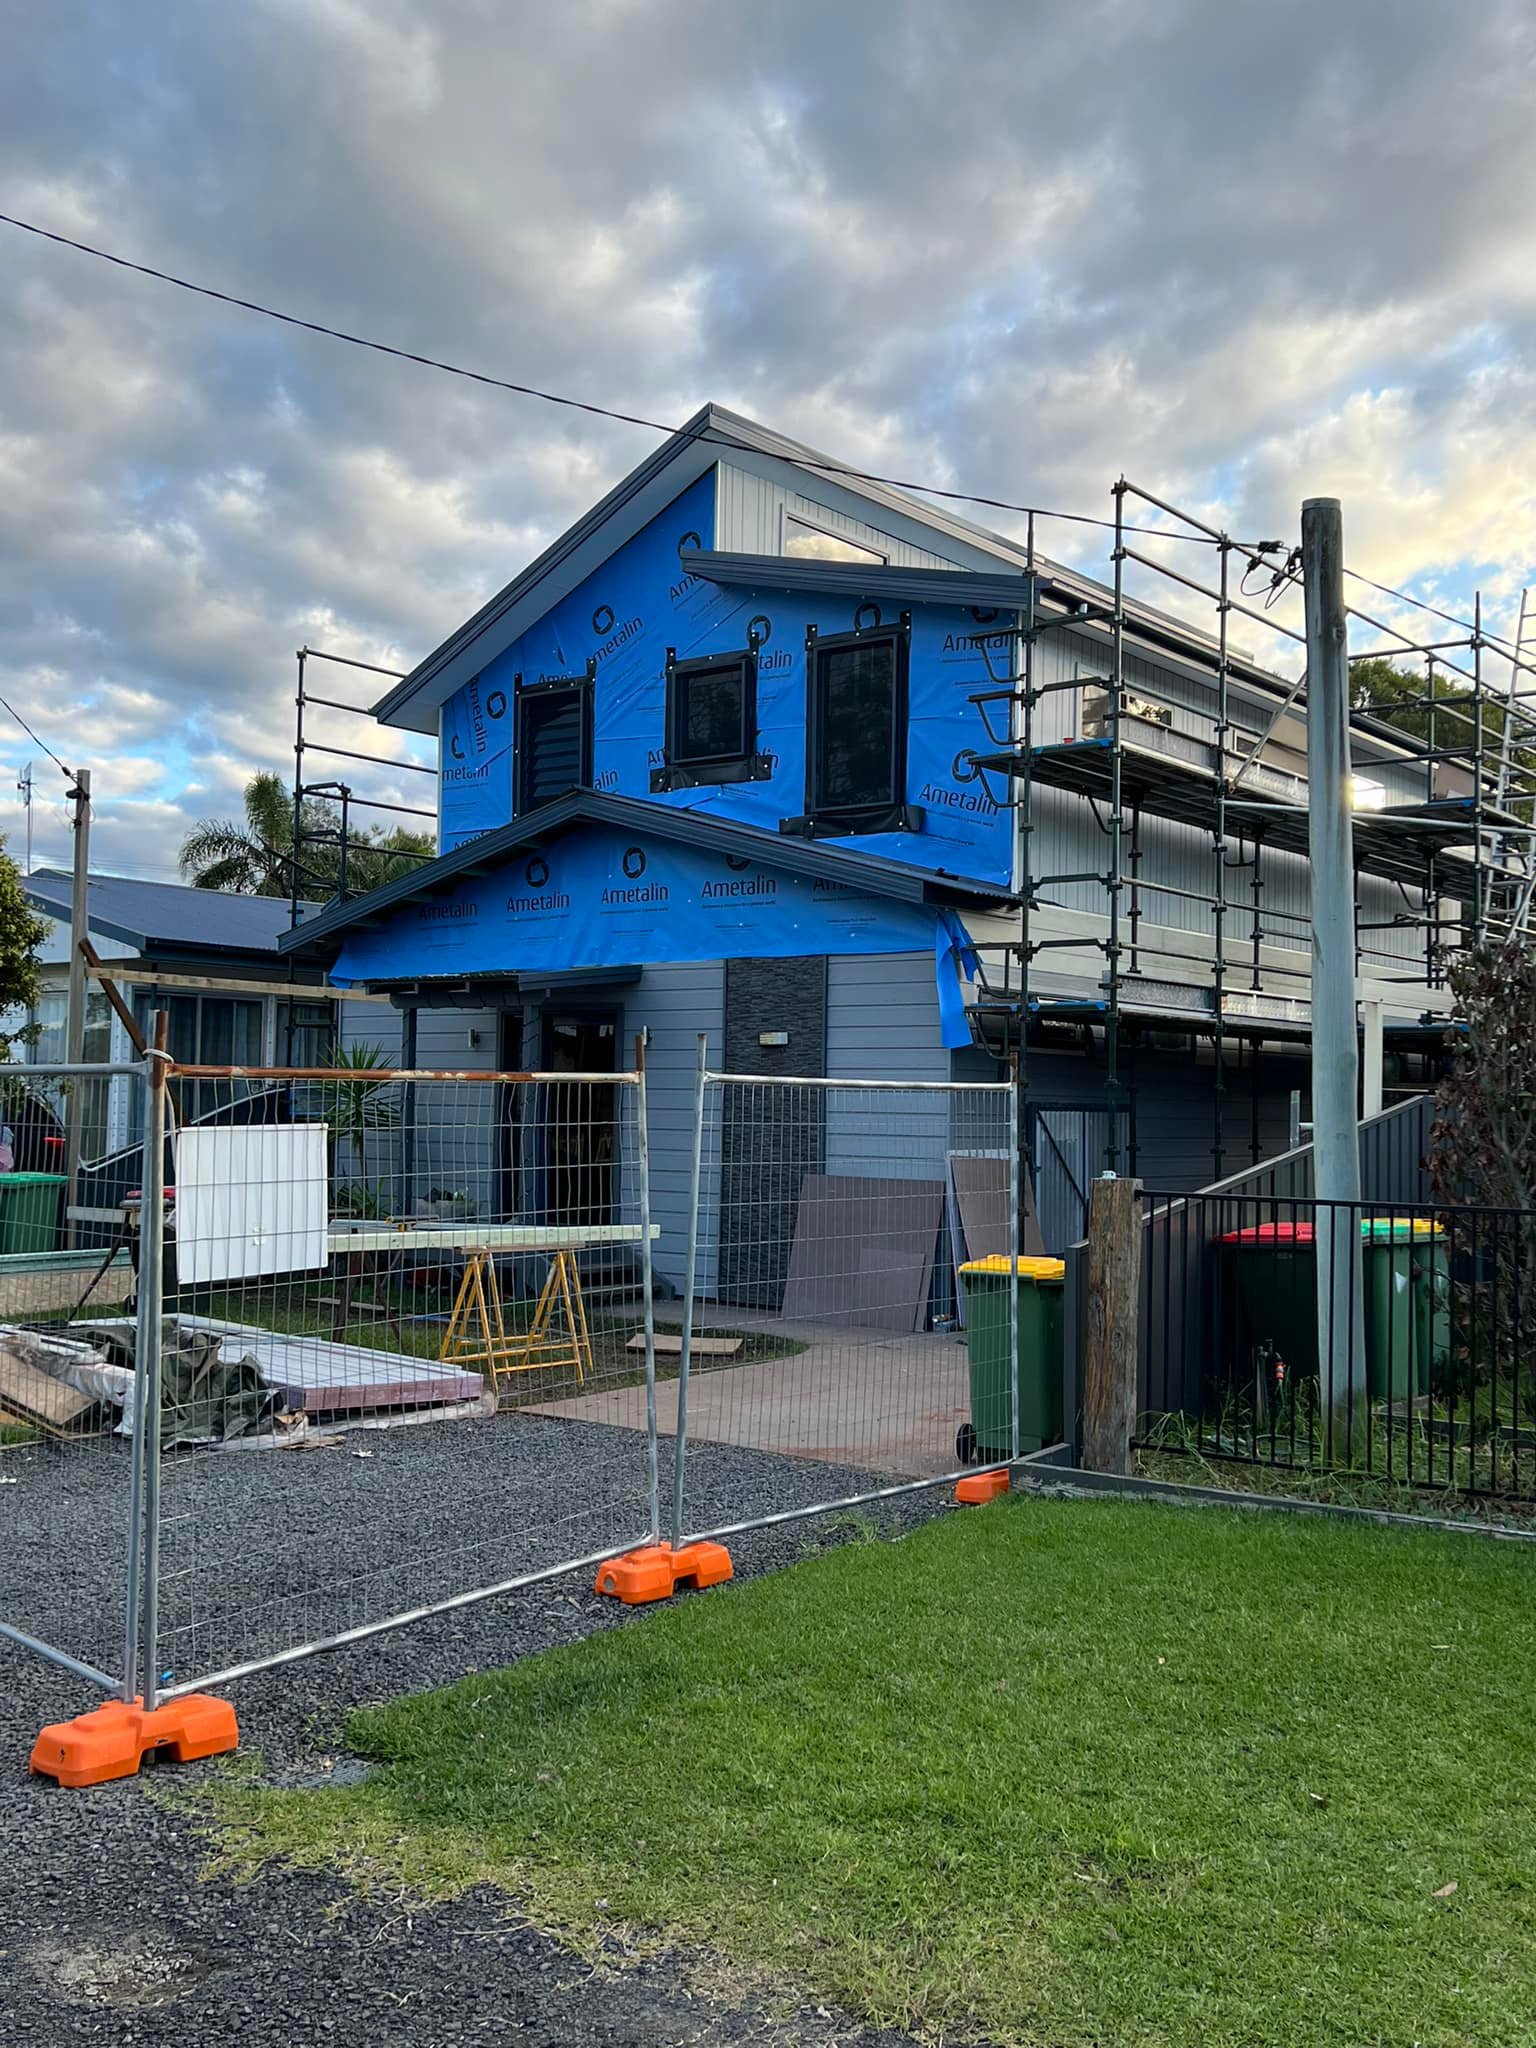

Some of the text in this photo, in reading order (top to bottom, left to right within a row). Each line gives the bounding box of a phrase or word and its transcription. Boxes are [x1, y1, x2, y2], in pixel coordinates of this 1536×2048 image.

[592, 616, 644, 662] metalin
[600, 881, 669, 904] Ametalin
[701, 874, 776, 897] Ametalin
[418, 901, 478, 920] Ametalin
[506, 891, 570, 912] Ametalin
